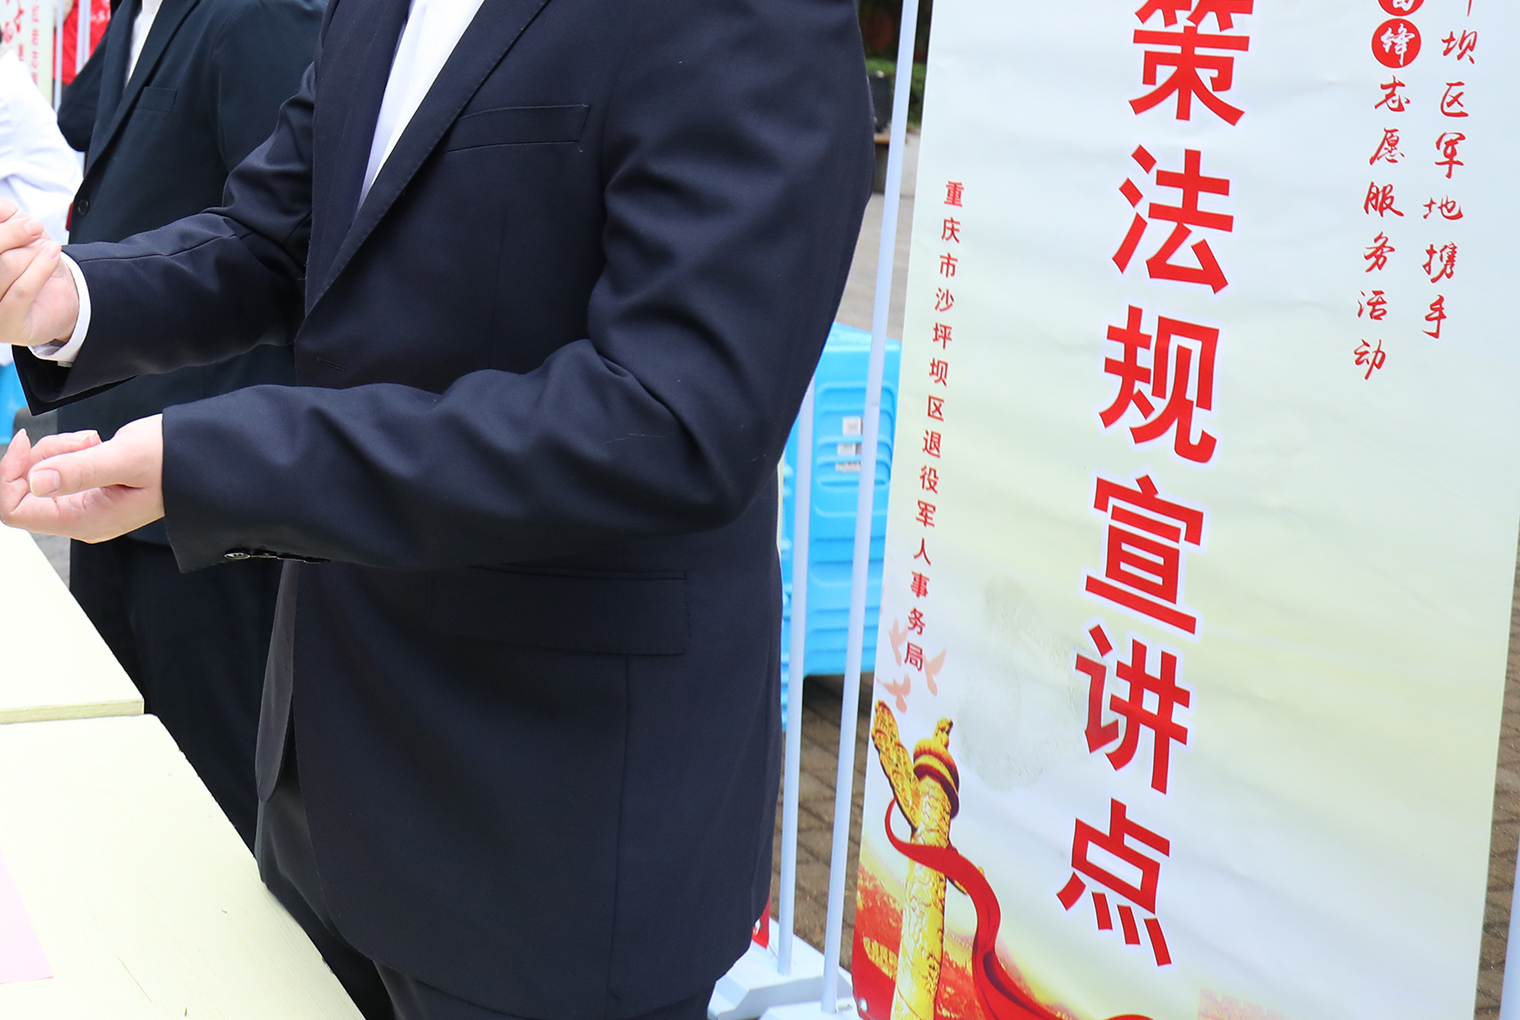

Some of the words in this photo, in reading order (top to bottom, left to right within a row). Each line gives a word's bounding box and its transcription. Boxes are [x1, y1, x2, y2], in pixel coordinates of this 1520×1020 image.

[904, 180, 966, 672] 重庆市沙坪坝区退役军人事务局
